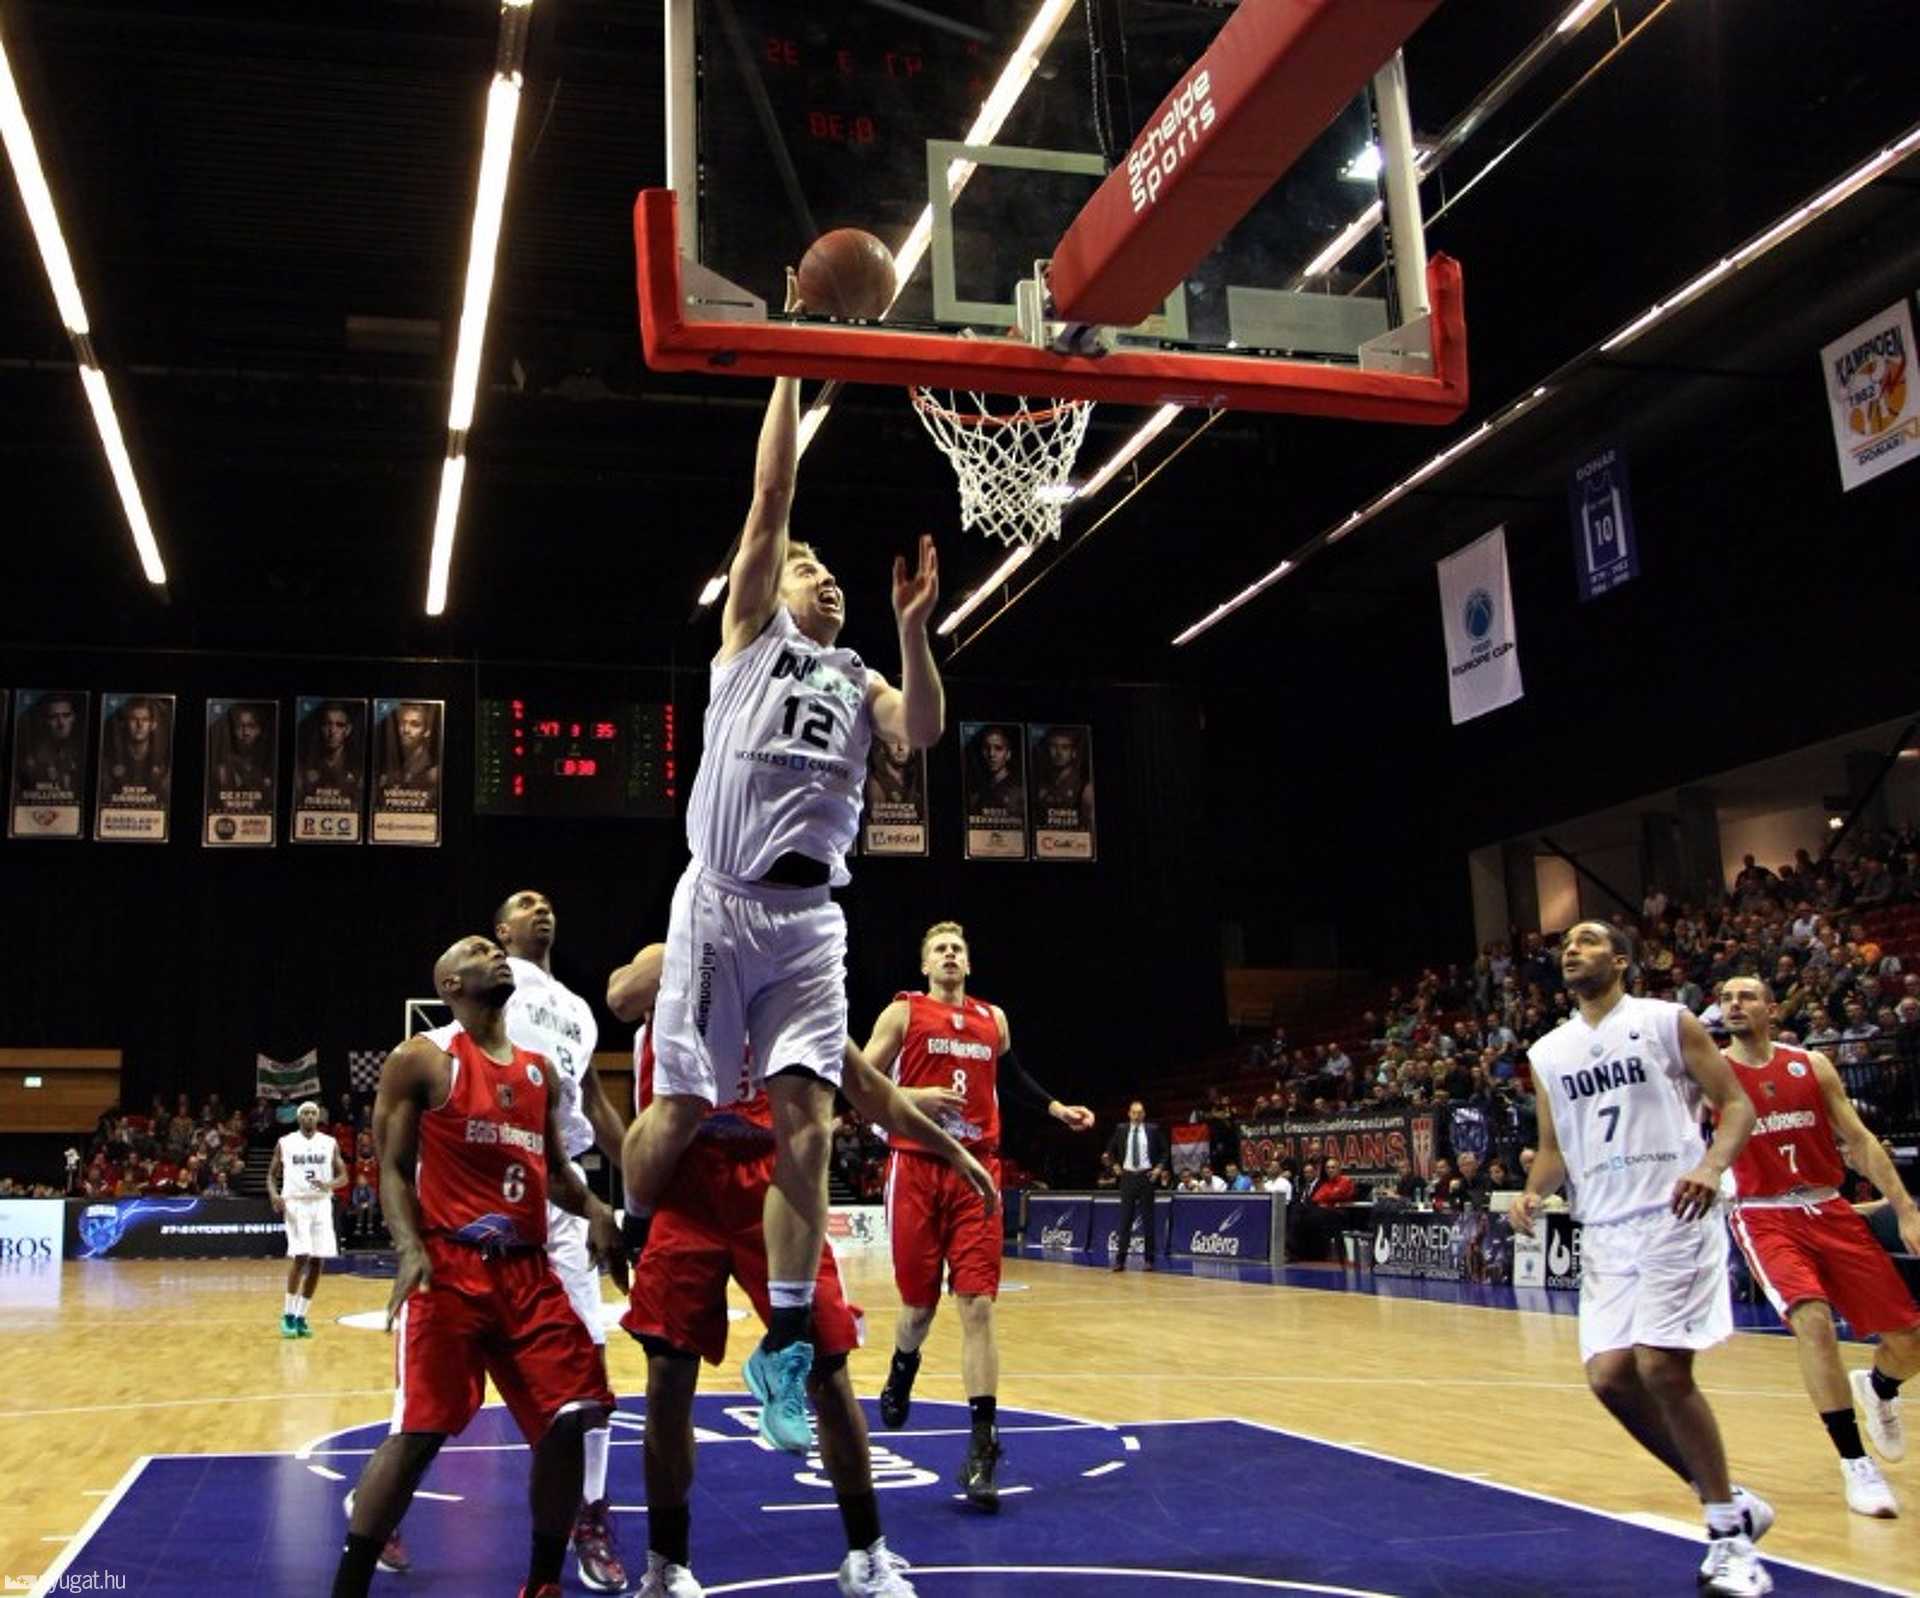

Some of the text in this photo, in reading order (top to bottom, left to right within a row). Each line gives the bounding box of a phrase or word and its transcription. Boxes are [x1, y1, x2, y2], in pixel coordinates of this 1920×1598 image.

[1835, 325, 1905, 387] KAMPIOEN
[1594, 514, 1614, 546] 10
[783, 695, 834, 749] 12
[952, 1069, 967, 1096] 8
[1561, 1056, 1646, 1100] DONAR
[1598, 1105, 1620, 1143] 7
[1777, 1144, 1799, 1174] 7
[503, 1164, 526, 1203] 6
